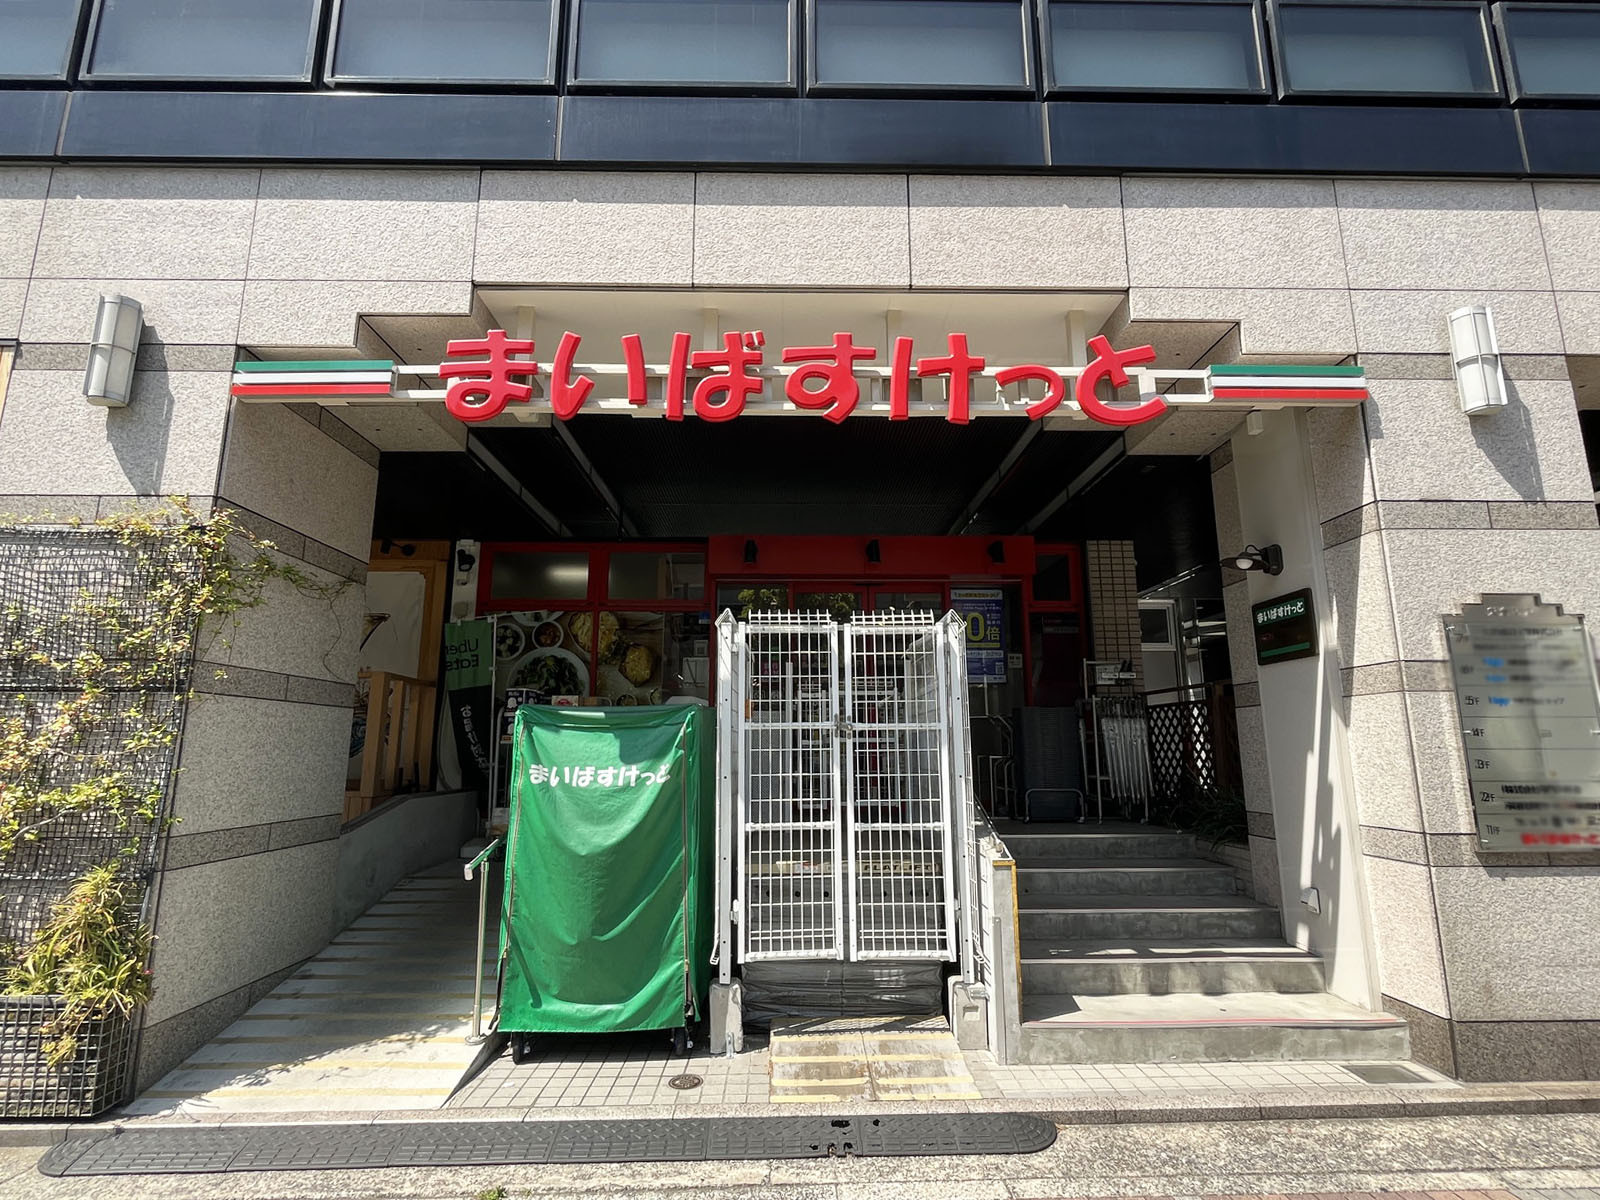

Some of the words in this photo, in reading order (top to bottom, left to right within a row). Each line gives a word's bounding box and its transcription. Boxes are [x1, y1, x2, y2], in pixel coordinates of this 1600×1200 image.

[439, 329, 1167, 425] まいばすけっと
[1257, 601, 1304, 623] まいばすけっと
[529, 763, 671, 788] まいばすけっと
